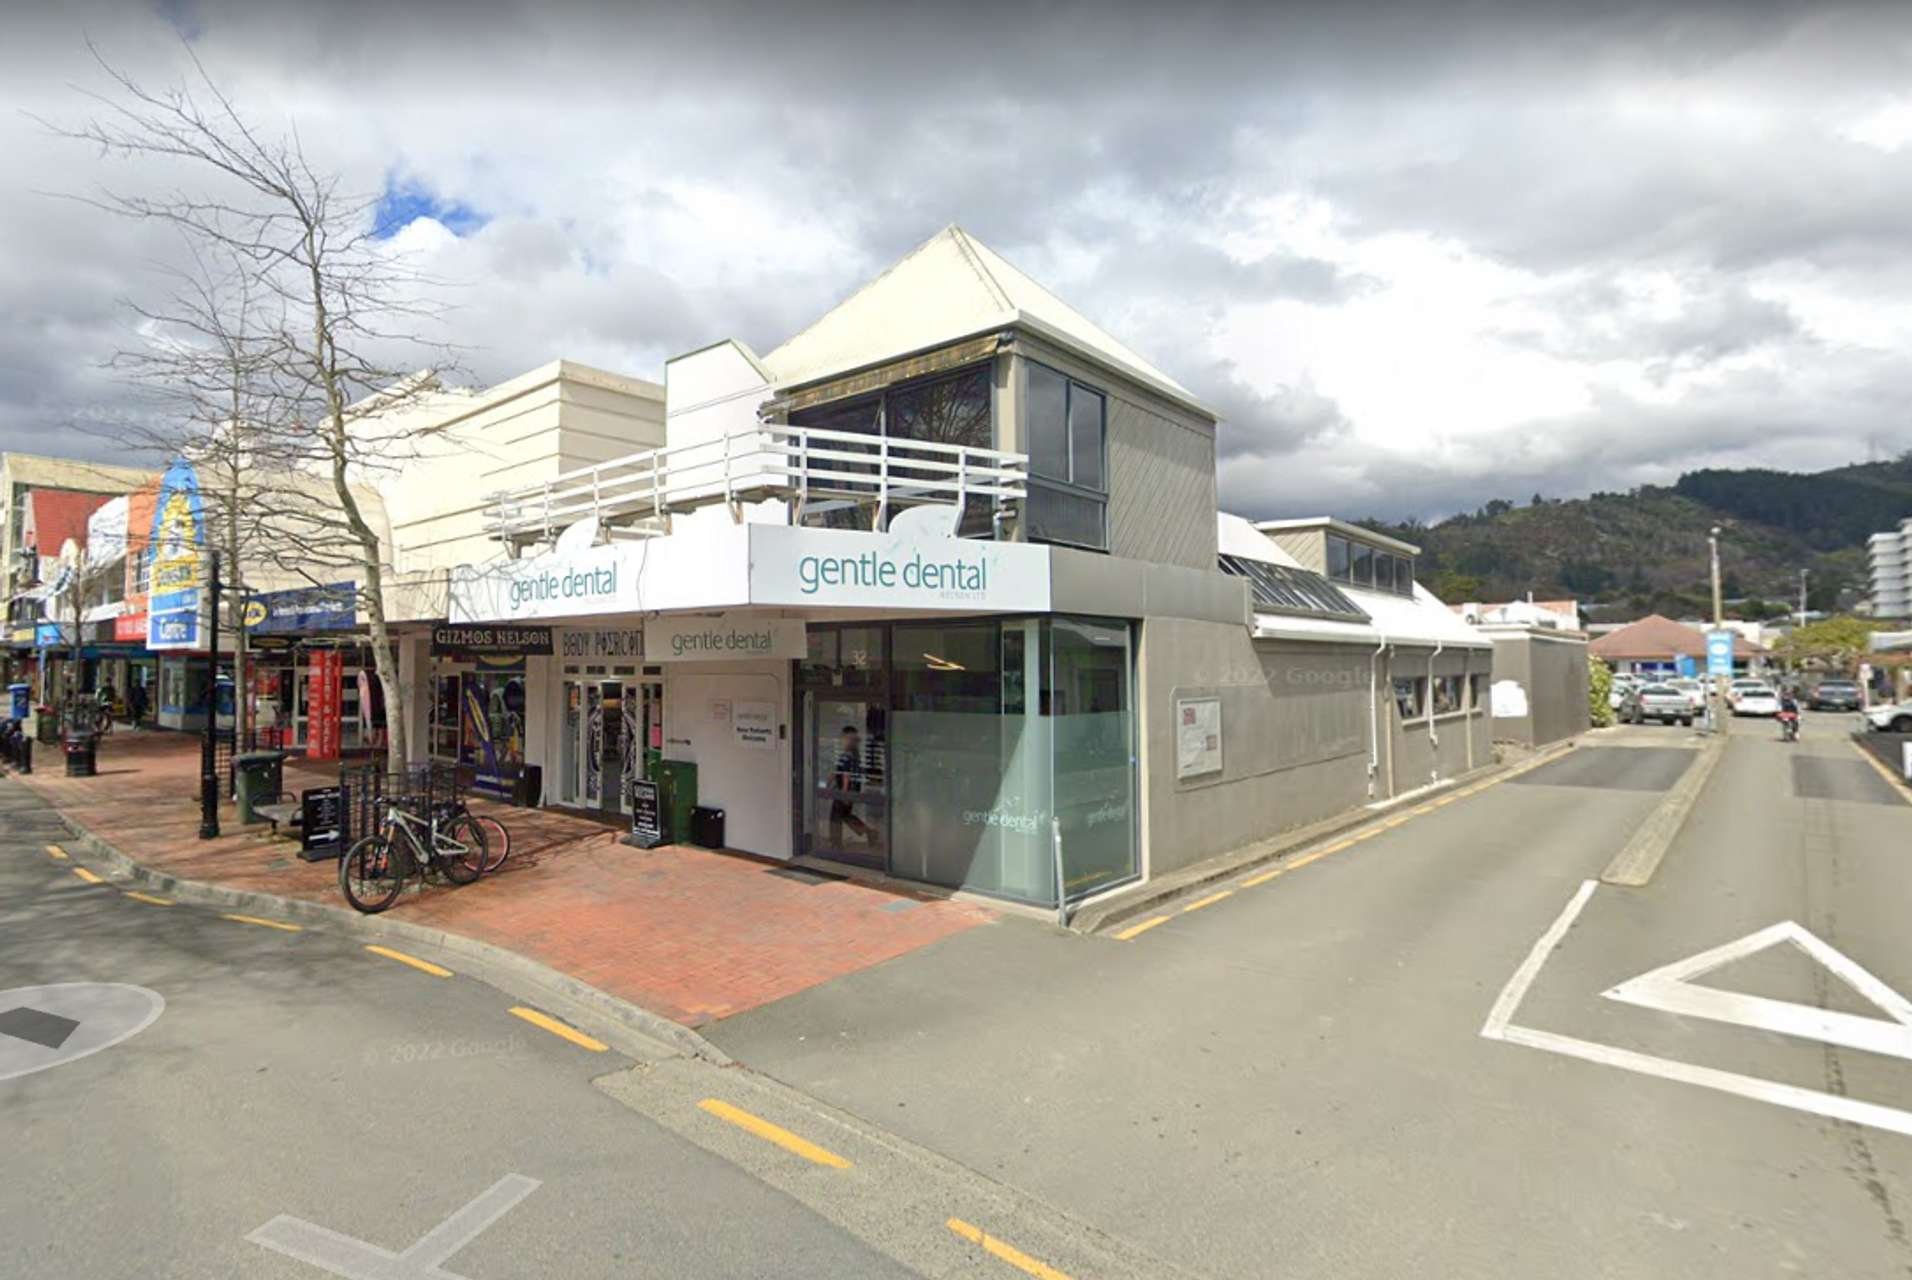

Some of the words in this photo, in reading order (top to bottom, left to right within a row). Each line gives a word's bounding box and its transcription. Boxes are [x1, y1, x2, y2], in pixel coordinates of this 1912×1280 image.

[510, 570, 559, 610] gentle
[562, 560, 617, 598] dental
[799, 552, 896, 594] gentle
[902, 553, 986, 590] dental
[435, 628, 493, 646] GIZMOS
[496, 629, 550, 646] NELSON
[672, 629, 722, 656] gentle
[725, 629, 772, 651] dental
